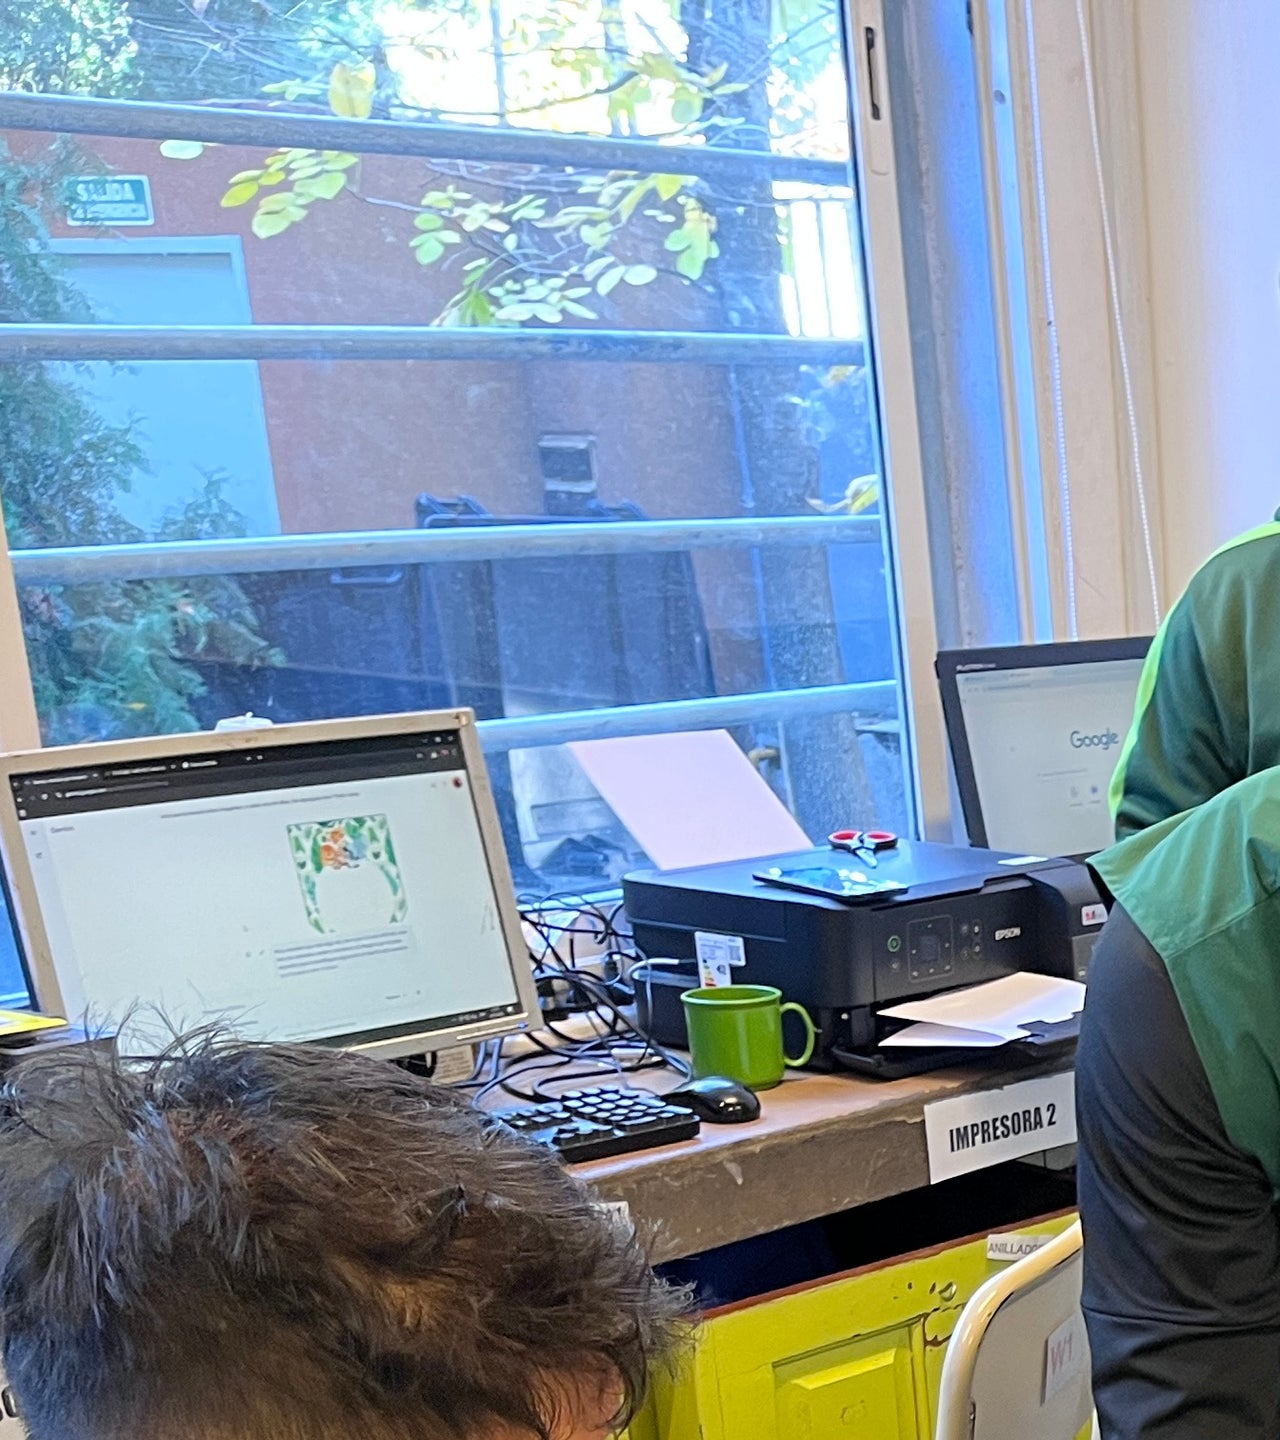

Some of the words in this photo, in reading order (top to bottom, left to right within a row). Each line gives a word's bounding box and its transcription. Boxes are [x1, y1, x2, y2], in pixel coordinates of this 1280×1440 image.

[1070, 727, 1119, 750] Google
[995, 927, 1021, 941] EPSON
[949, 1106, 1043, 1152] IMPRESORA
[1046, 1103, 1056, 1126] 2
